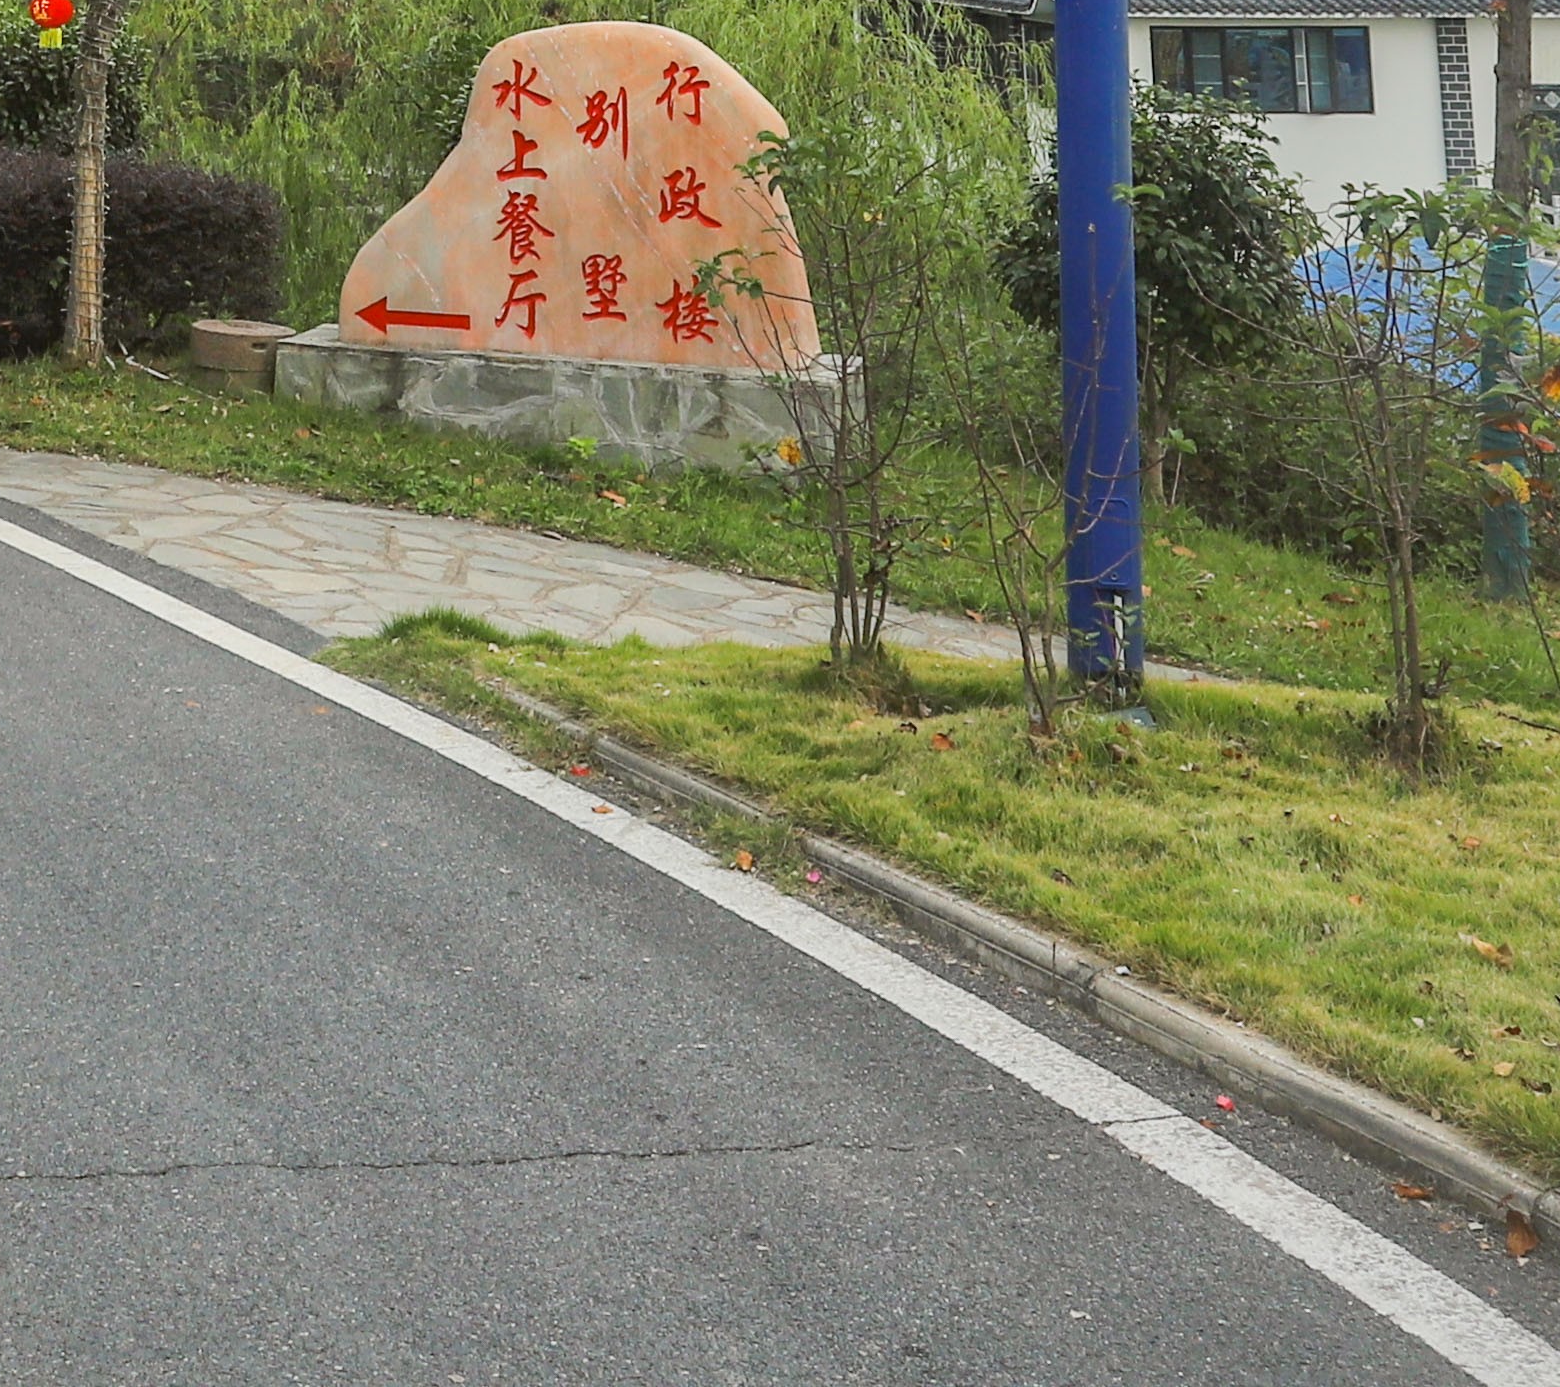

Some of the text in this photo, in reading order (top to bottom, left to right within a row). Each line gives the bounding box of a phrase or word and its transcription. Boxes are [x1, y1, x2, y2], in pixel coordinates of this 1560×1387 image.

[492, 57, 555, 341] 水上餐厅
[575, 85, 629, 323] 别墅
[654, 60, 723, 345] 行政楼
